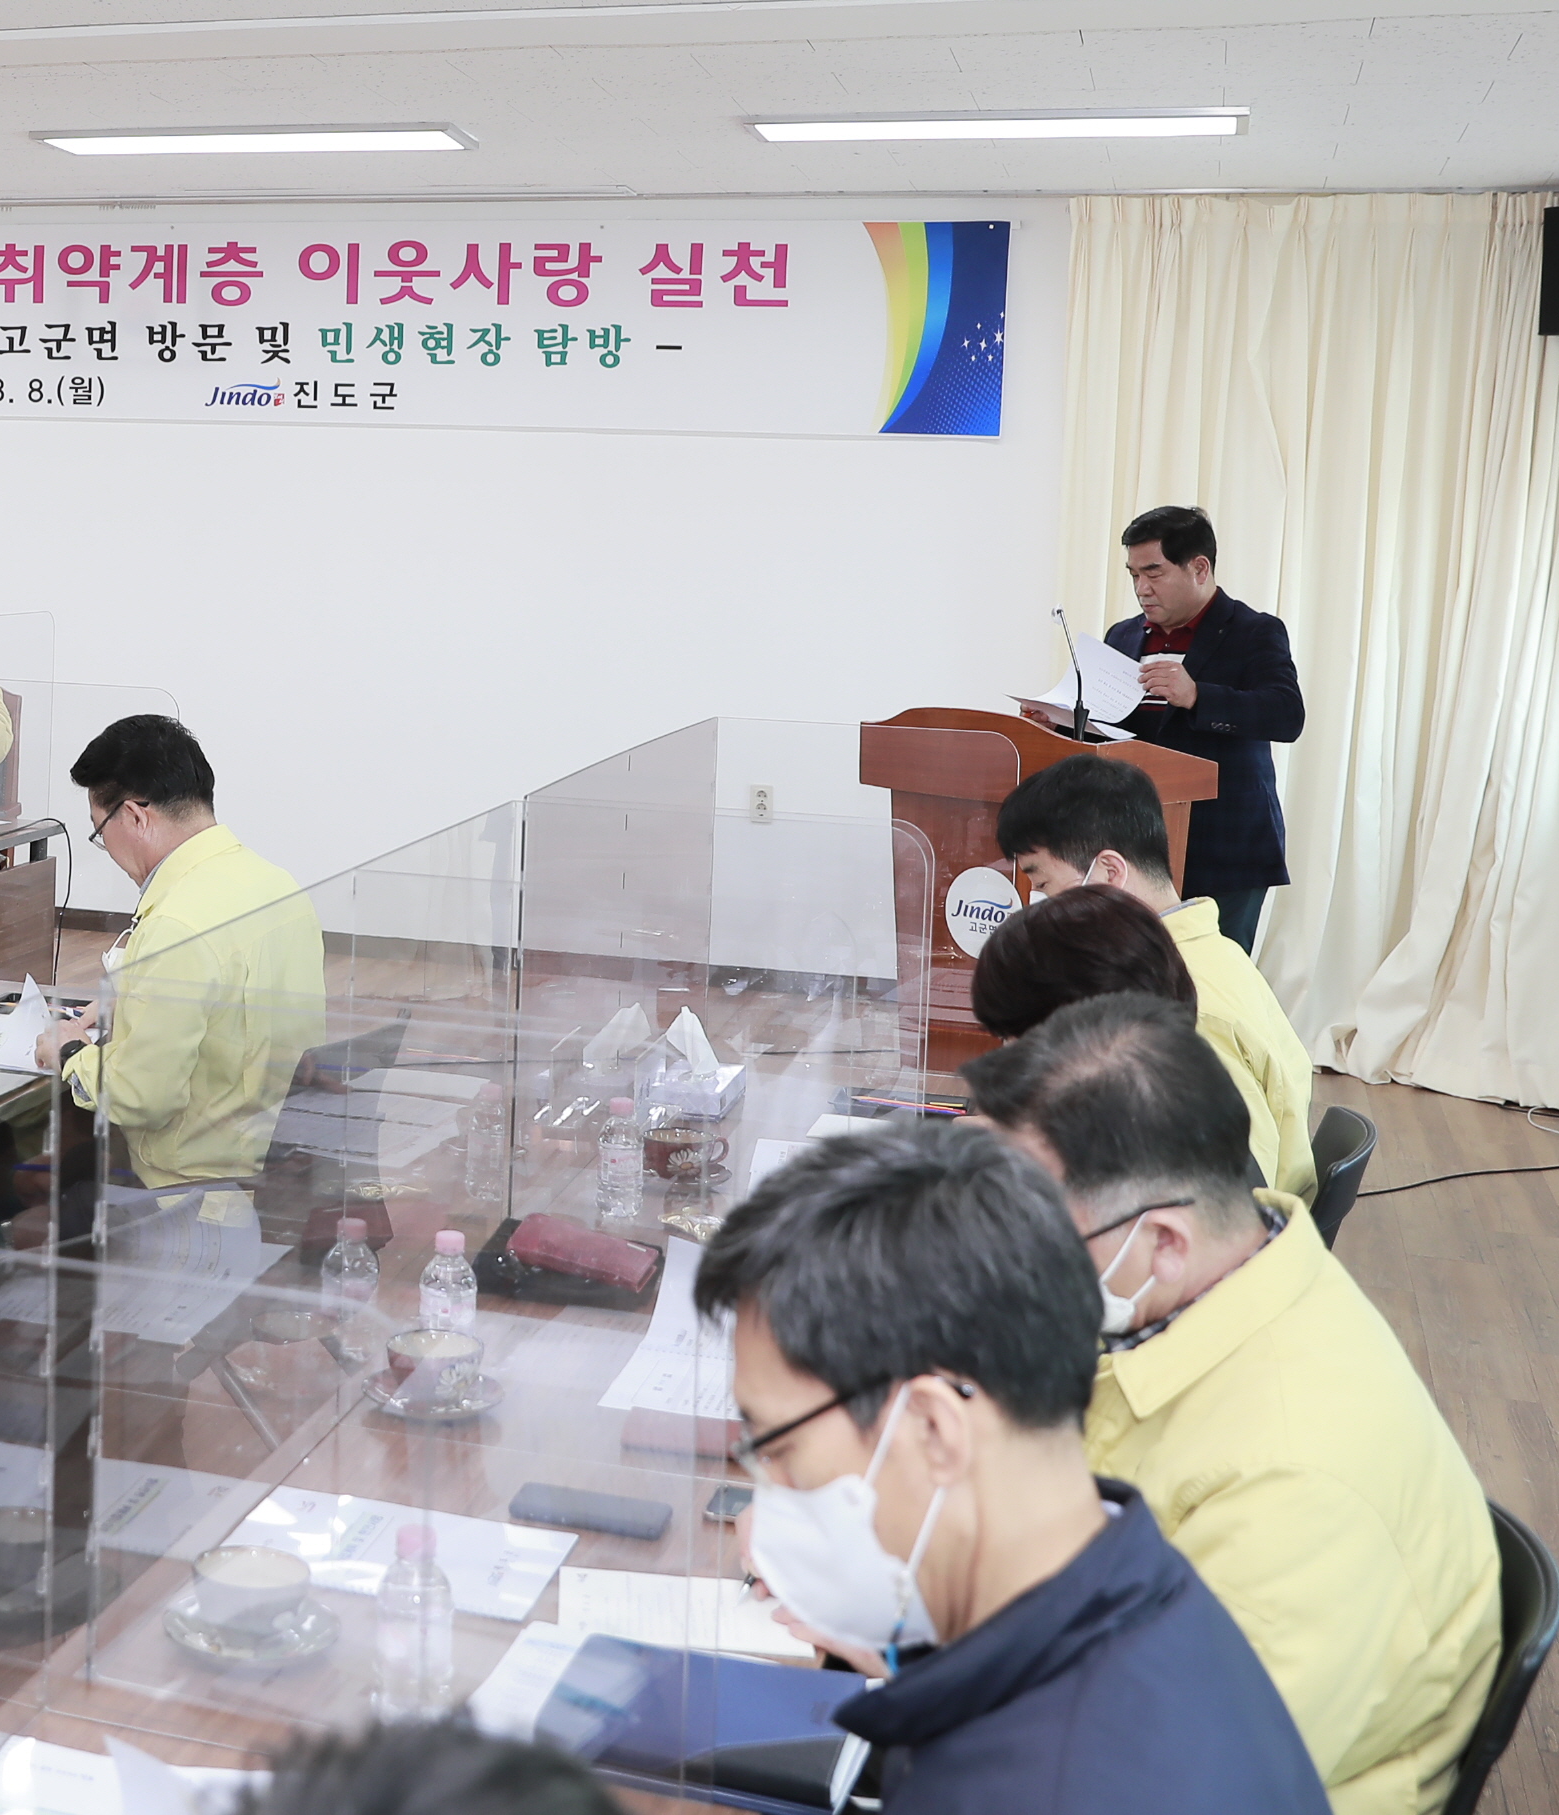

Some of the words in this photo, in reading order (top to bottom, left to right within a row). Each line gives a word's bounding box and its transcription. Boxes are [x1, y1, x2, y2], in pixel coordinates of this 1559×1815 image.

[298, 240, 603, 308] 이웃사랑
[639, 242, 789, 309] 실천
[146, 320, 233, 363] 방문
[255, 321, 291, 365] 및
[317, 321, 512, 367] 민생현장
[533, 323, 632, 369] 탐방
[205, 386, 272, 407] Jindo
[292, 380, 398, 411] 진도군
[951, 899, 1005, 923] Jindo
